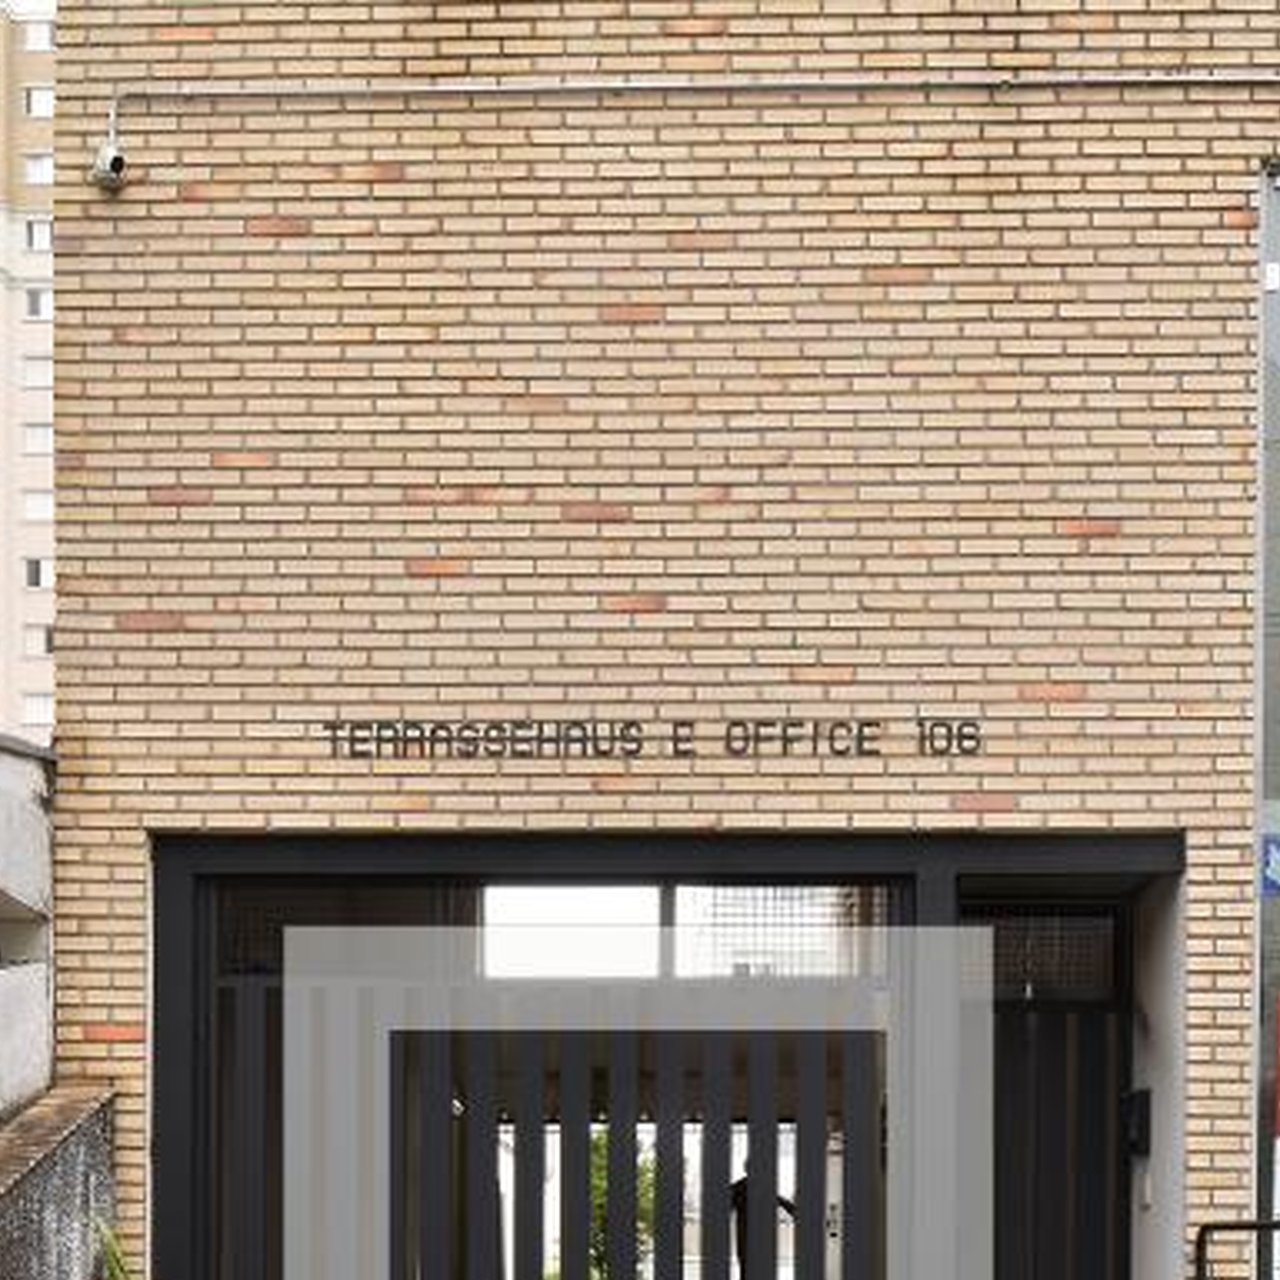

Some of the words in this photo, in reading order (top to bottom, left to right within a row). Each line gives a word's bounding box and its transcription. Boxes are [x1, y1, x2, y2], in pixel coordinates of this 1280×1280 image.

[323, 720, 644, 759] TERRASSEHAUS
[673, 721, 694, 757] E
[724, 720, 882, 758] OFFICE
[917, 720, 982, 757] 106
